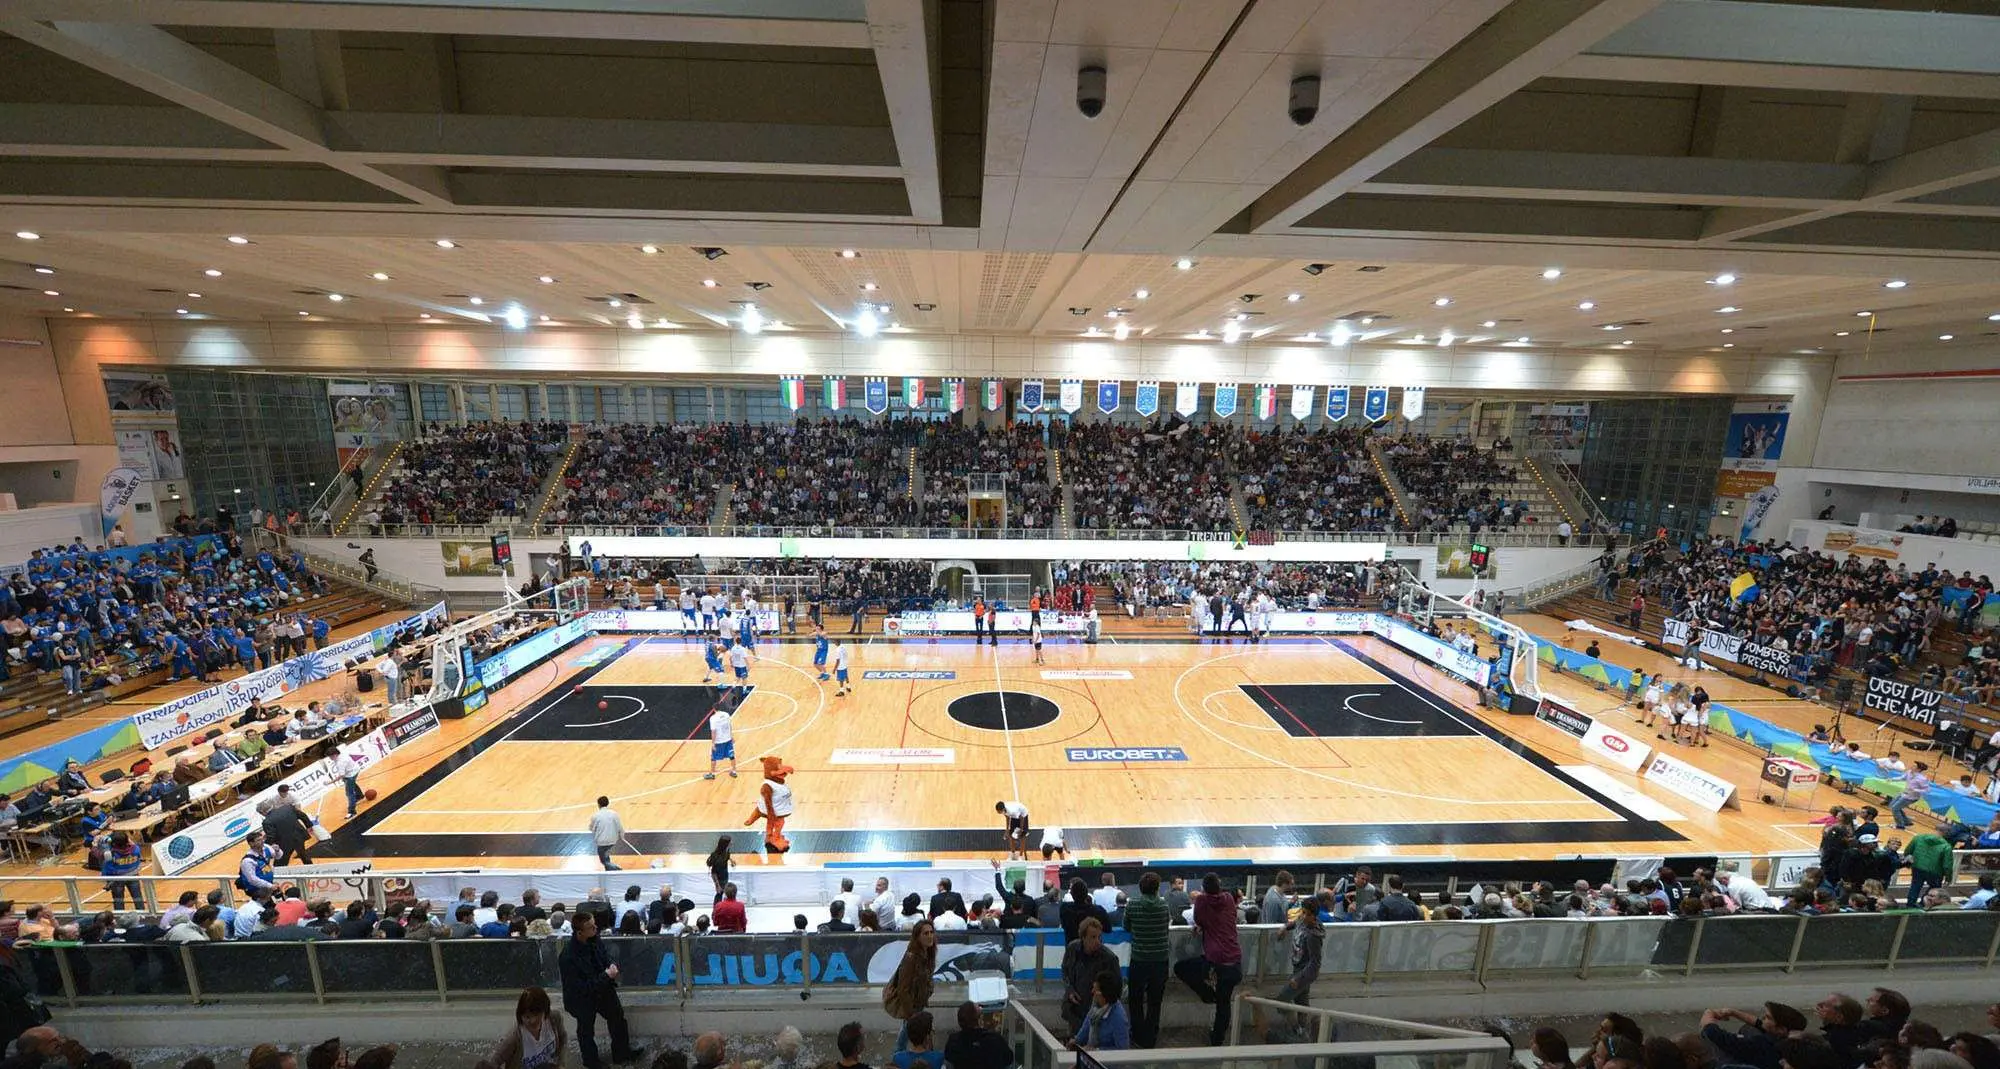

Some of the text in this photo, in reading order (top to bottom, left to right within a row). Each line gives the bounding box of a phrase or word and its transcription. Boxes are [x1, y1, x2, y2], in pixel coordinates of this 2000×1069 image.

[119, 476, 141, 506] BASKET
[1868, 676, 1909, 699] OGGI
[136, 686, 220, 726] IRRIDUCIBILI
[1865, 692, 1937, 725] CHE MAI
[150, 706, 225, 746] ZANZARONI
[1070, 749, 1167, 761] EUROBET
